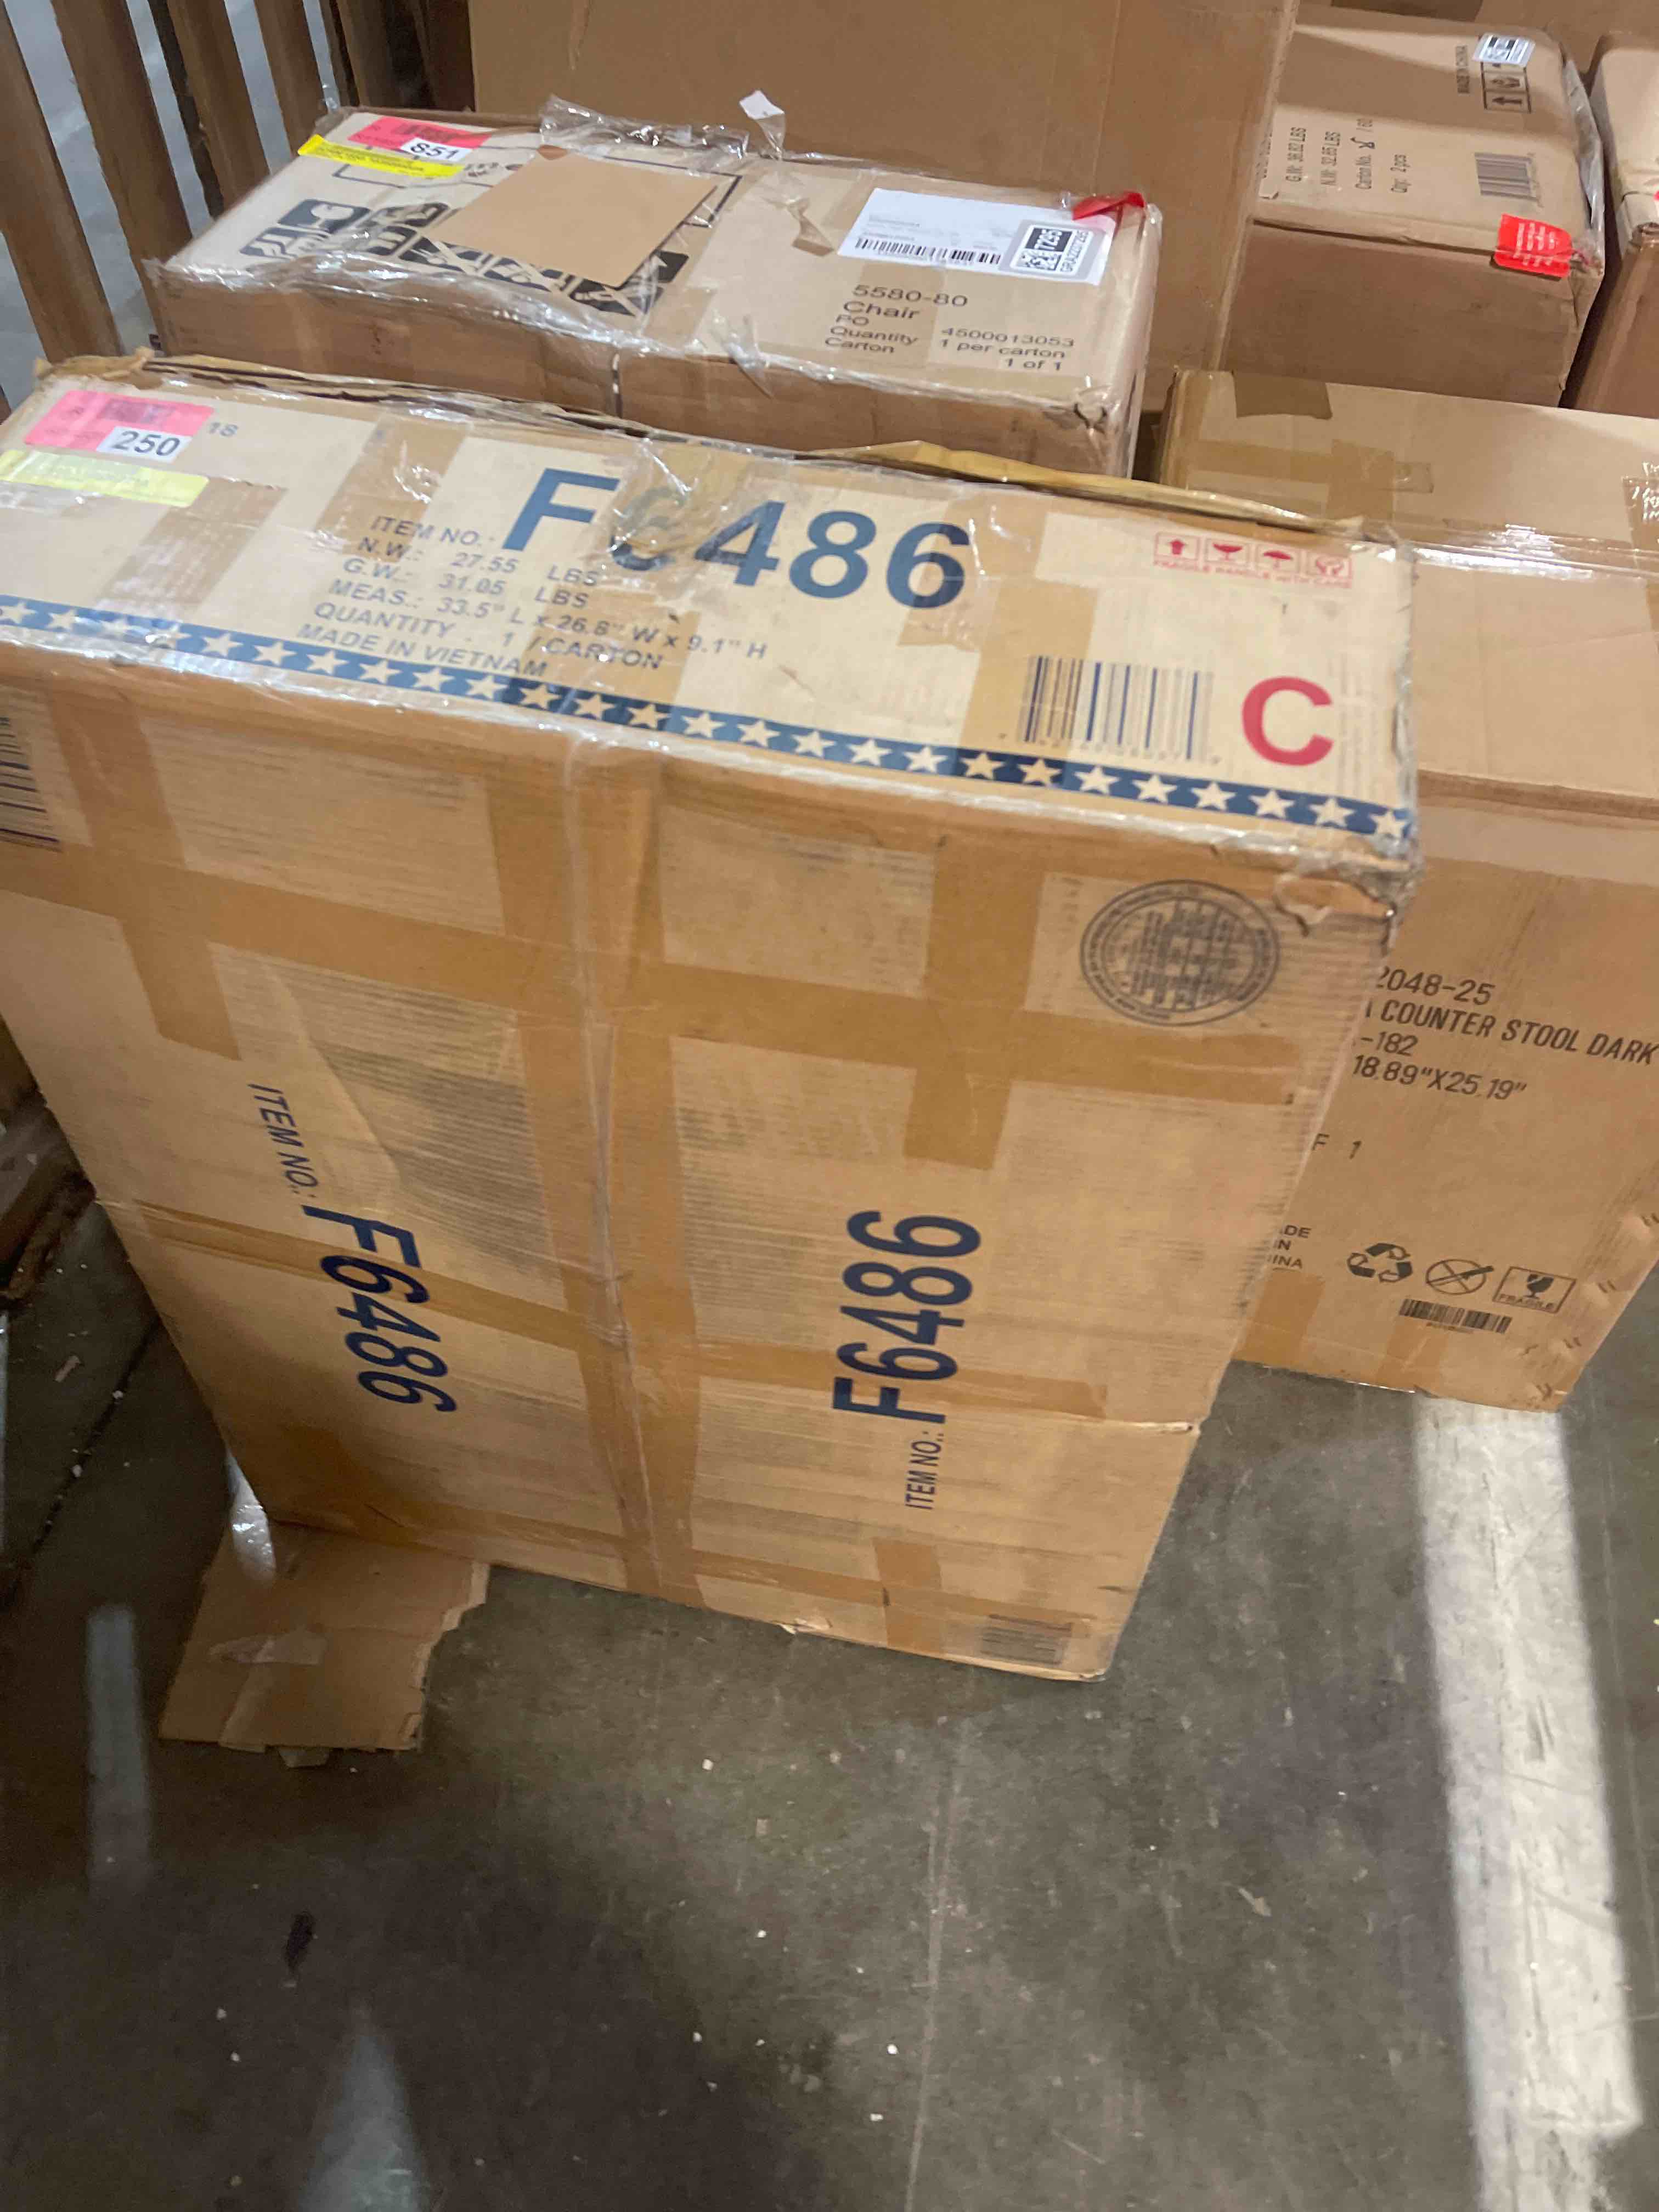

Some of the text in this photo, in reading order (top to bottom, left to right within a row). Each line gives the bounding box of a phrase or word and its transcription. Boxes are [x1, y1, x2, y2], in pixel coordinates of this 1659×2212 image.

[408, 142, 459, 160] 851
[1289, 127, 1306, 142] LBS
[1324, 132, 1340, 146] LBS
[843, 301, 921, 319] Chair
[853, 284, 968, 307] 5580-80
[830, 326, 1066, 359] Quantity 1 per carton
[836, 314, 1075, 348] PO 4500013053
[824, 337, 1062, 371] Carton 1 of 1
[112, 430, 180, 456] 250
[370, 515, 435, 540] ITEM
[451, 552, 520, 573] 27.55
[547, 564, 599, 587] LBS
[438, 573, 507, 596] 31.05
[534, 586, 589, 610] LBS
[314, 602, 456, 639] QUANTITY
[510, 607, 524, 624] L
[633, 625, 659, 644] W
[747, 642, 768, 659] H
[298, 623, 548, 678] MADE IN VIETNAM
[1241, 676, 1334, 767] C
[1381, 999, 1497, 1038] COUNTER
[1502, 1018, 1580, 1052] STOOL
[1587, 1032, 1658, 1065] DARK
[247, 1082, 305, 1148] ITEM
[1349, 1140, 1362, 1159] 1
[1279, 1224, 1312, 1239] DE
[300, 1204, 458, 1413] F6486
[831, 1210, 983, 1425] F6486
[904, 1470, 939, 1510] ITEM
